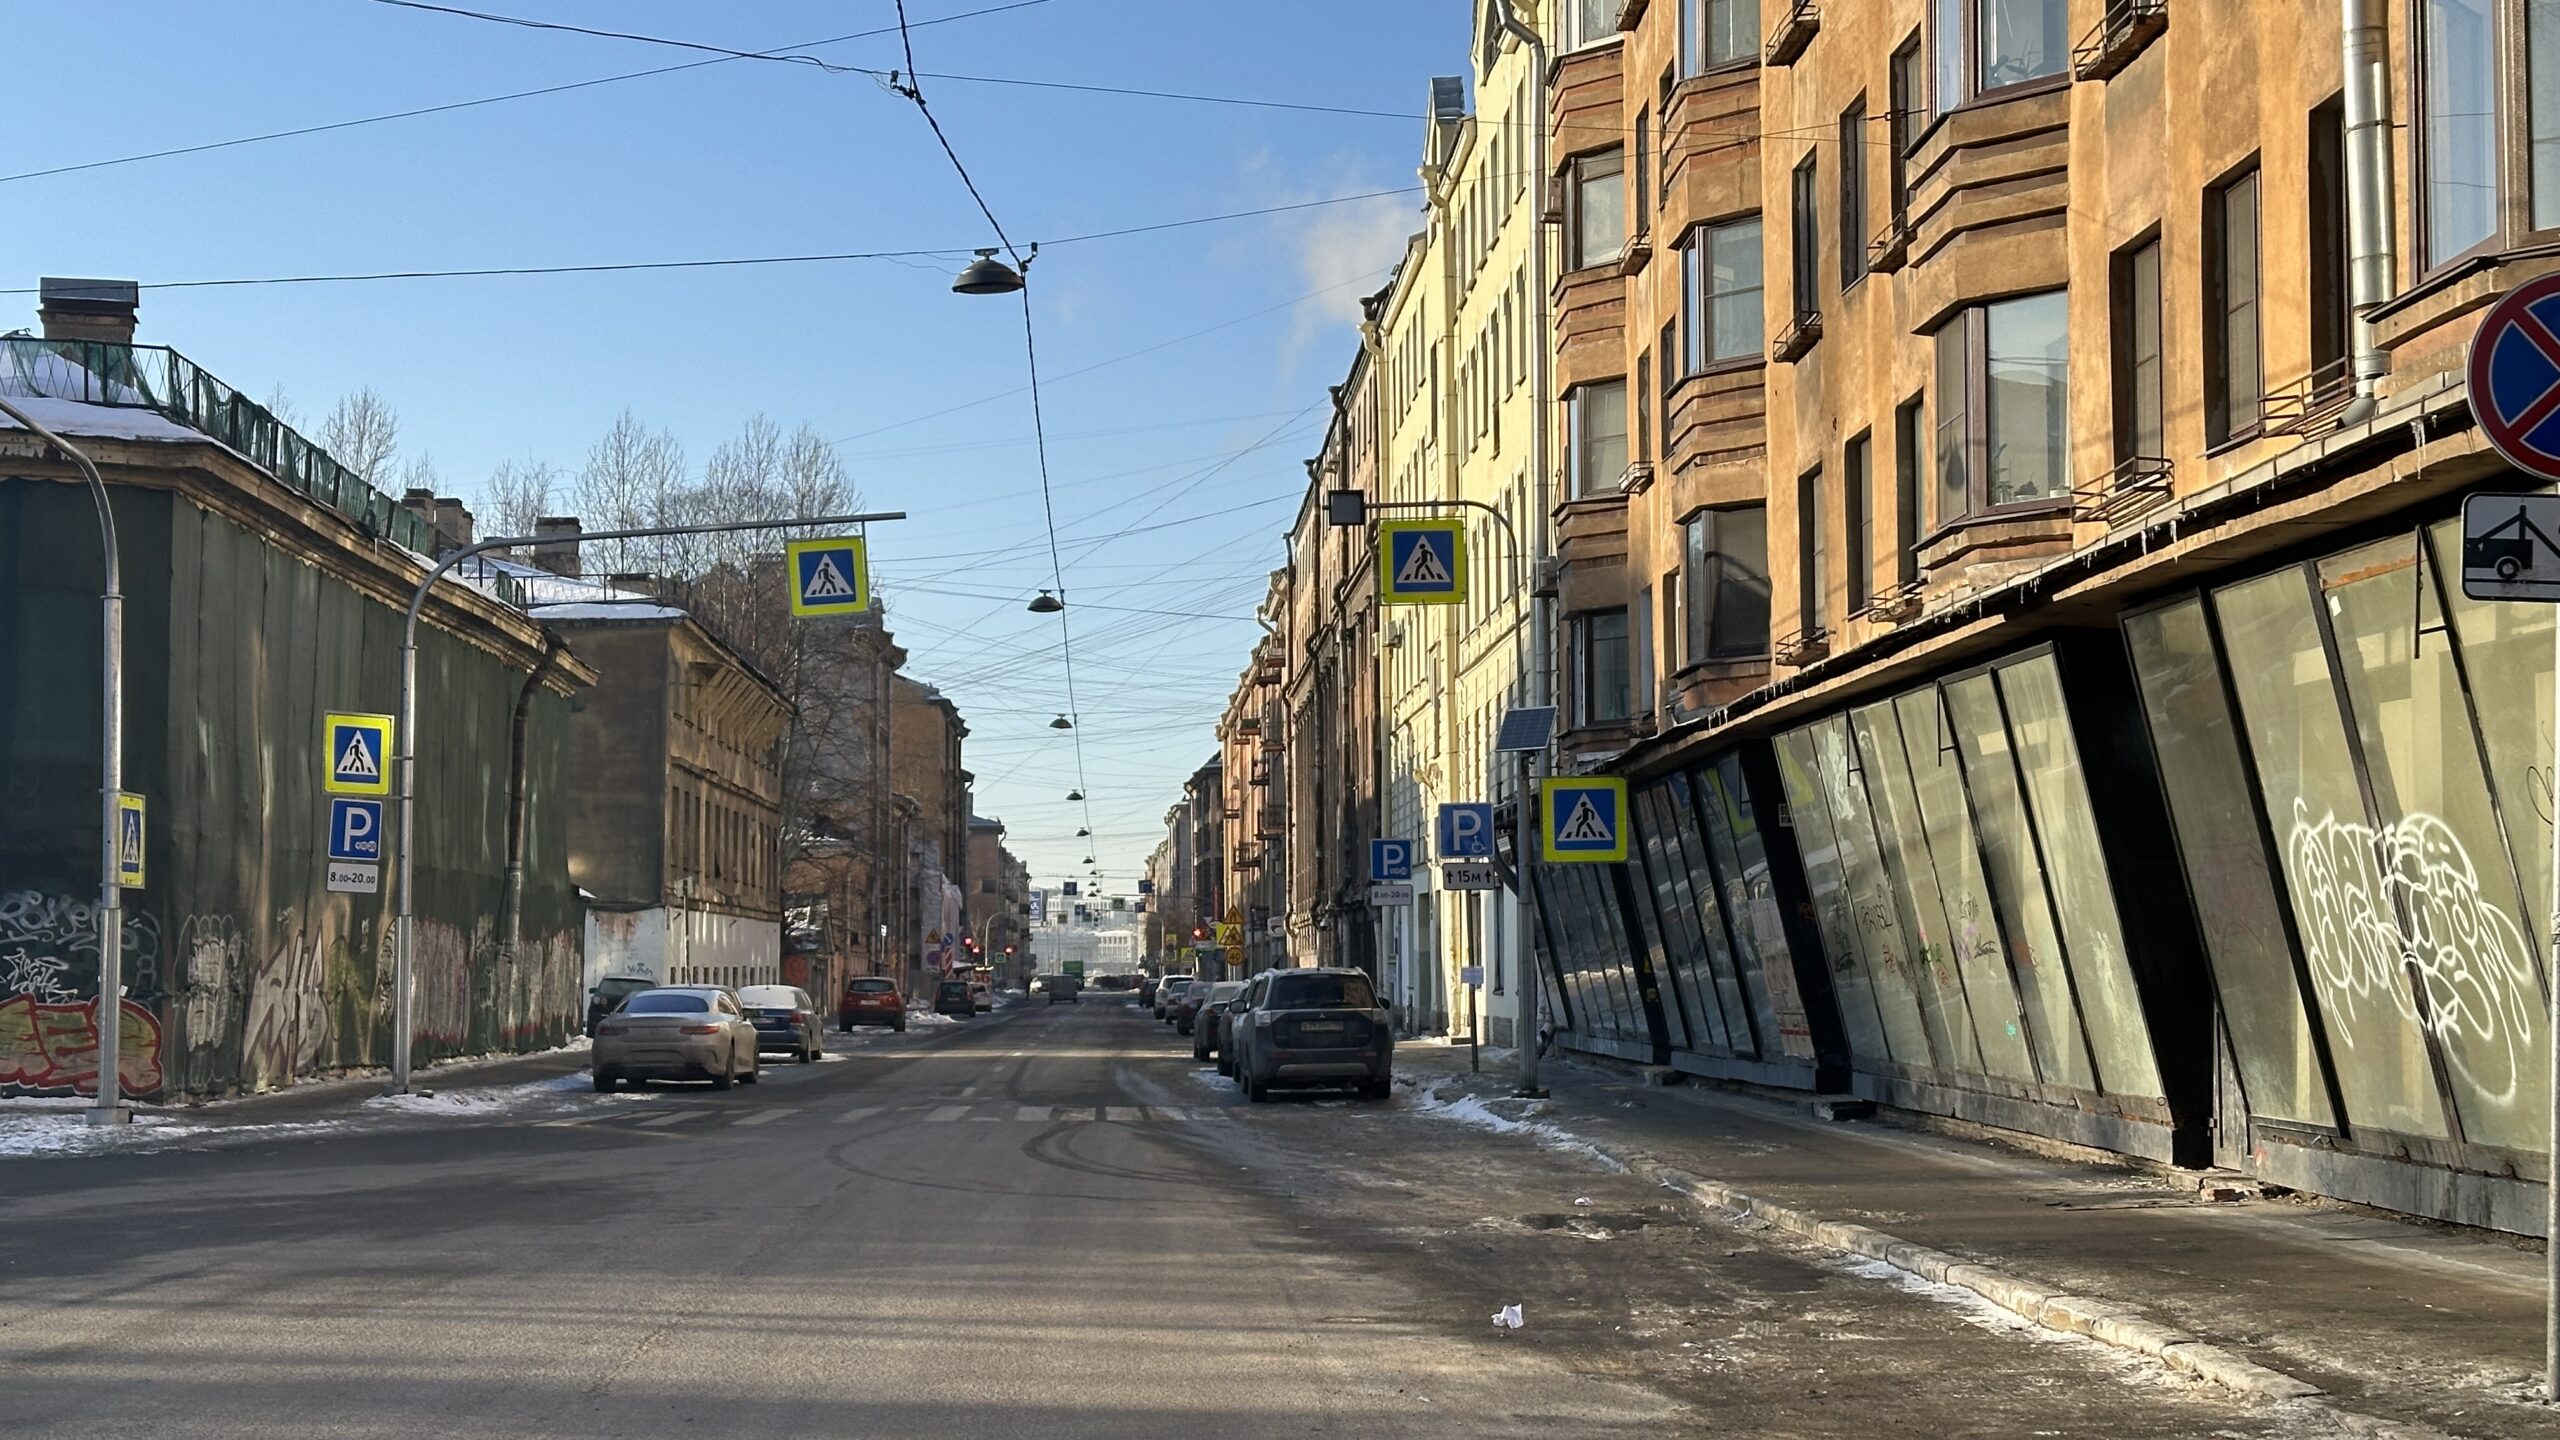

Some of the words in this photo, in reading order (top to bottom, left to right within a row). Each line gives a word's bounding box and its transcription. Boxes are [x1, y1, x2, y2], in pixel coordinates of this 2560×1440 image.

[344, 807, 371, 851] P
[1453, 810, 1481, 851] P
[330, 872, 375, 884] 8.00-20.00
[1383, 844, 1404, 876] P
